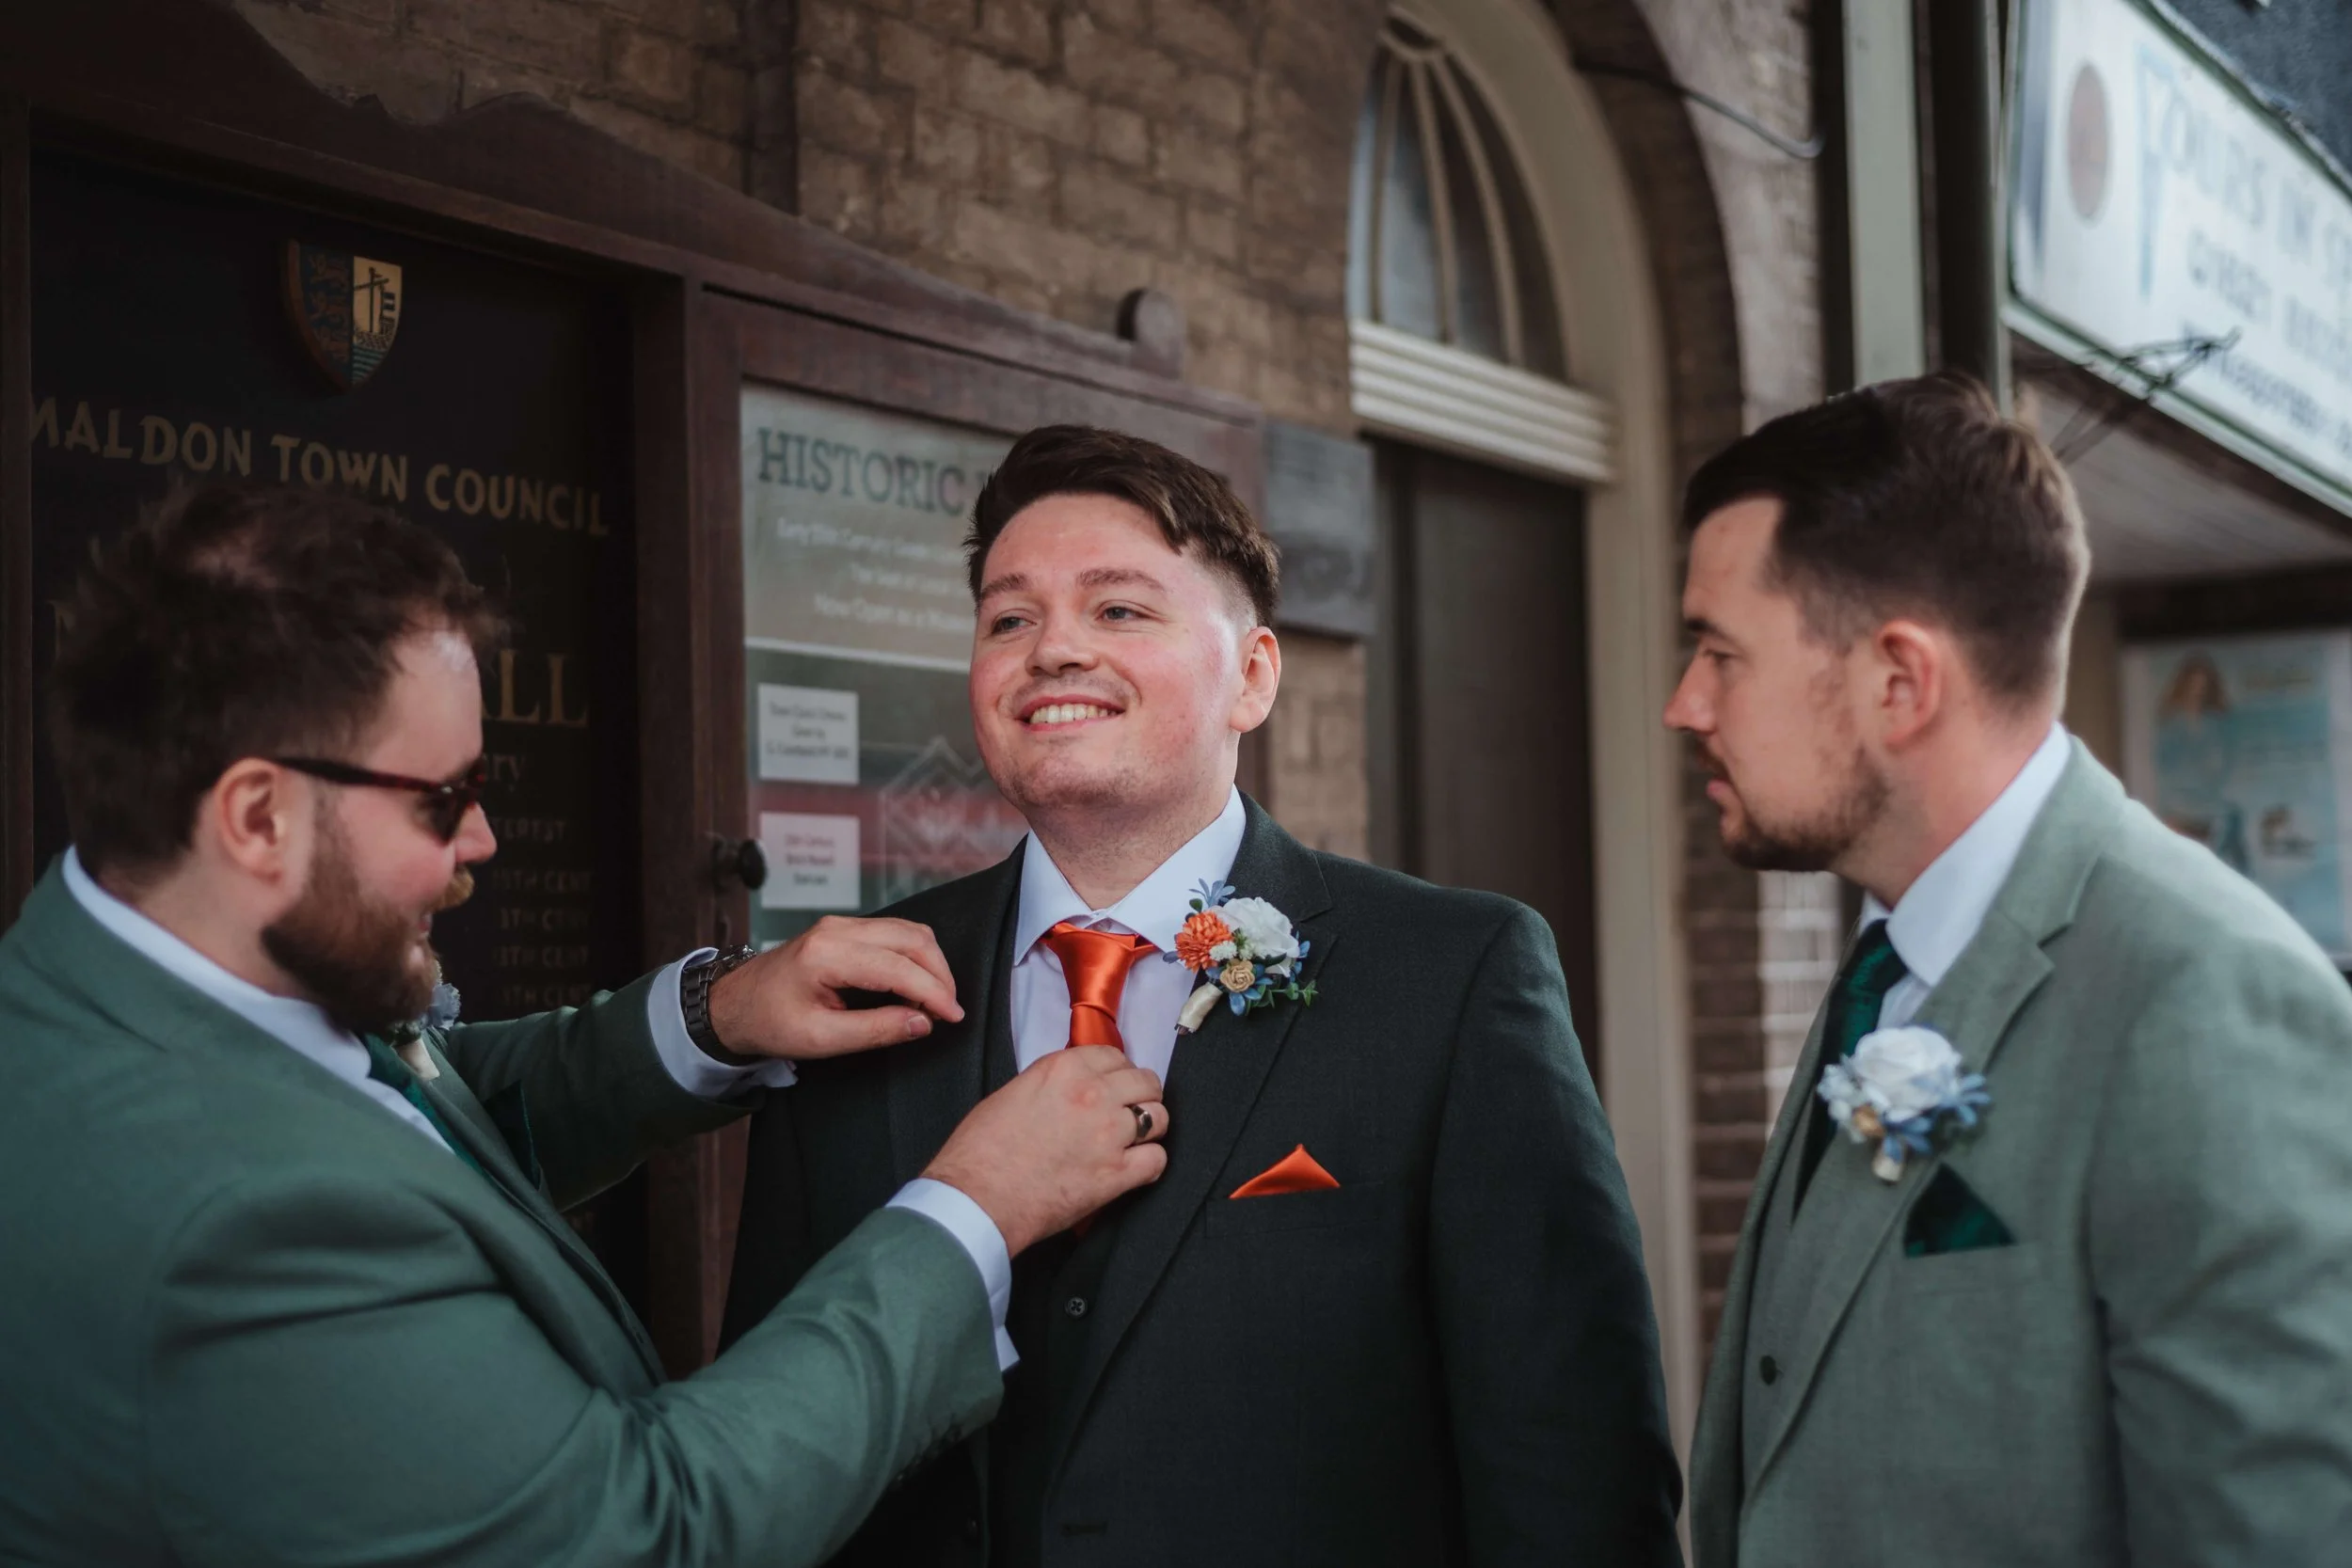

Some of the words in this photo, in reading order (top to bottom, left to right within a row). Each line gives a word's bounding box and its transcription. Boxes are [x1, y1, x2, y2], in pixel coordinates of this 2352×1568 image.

[30, 392, 252, 478] MALDON
[271, 434, 409, 502] TOWN
[425, 462, 610, 536] COUNCIL
[756, 426, 965, 517] HISTORIC
[482, 648, 589, 729] LL
